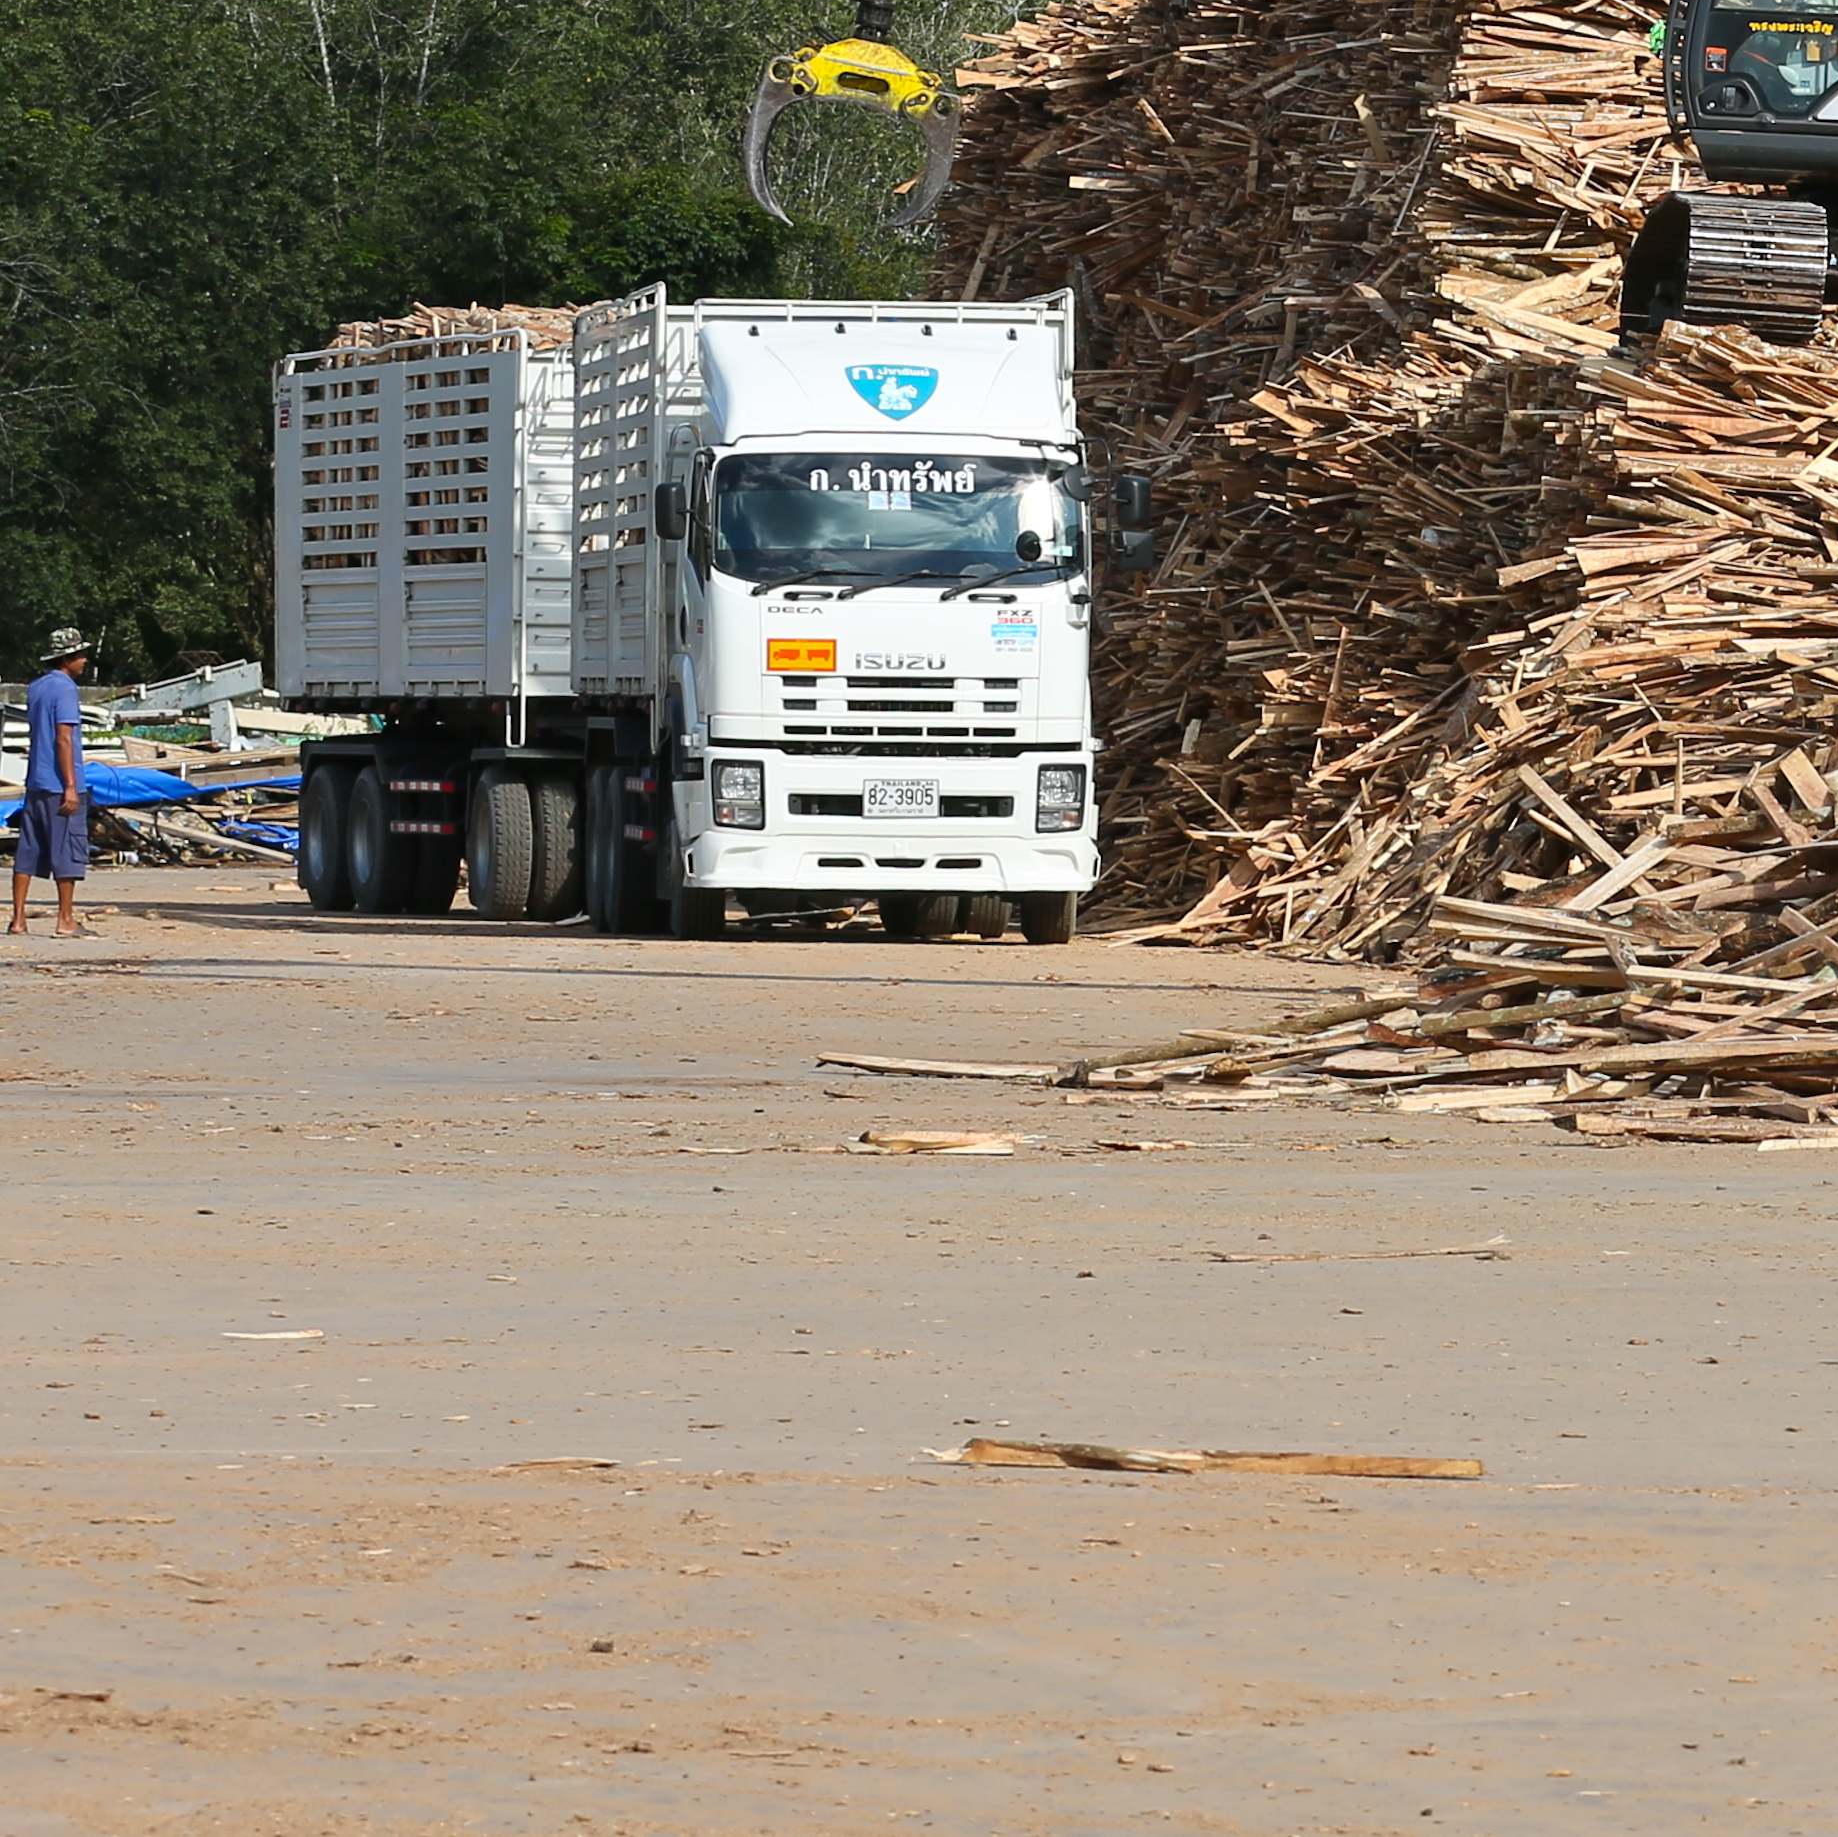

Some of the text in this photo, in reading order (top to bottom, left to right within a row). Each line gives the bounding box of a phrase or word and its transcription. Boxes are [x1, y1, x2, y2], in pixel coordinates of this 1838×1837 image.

[809, 460, 978, 493] ก. นำทรัพย์
[767, 606, 823, 614] DECA
[997, 609, 1033, 617] FXZ
[855, 653, 946, 670] ISUZU
[868, 788, 934, 806] 82-3905
